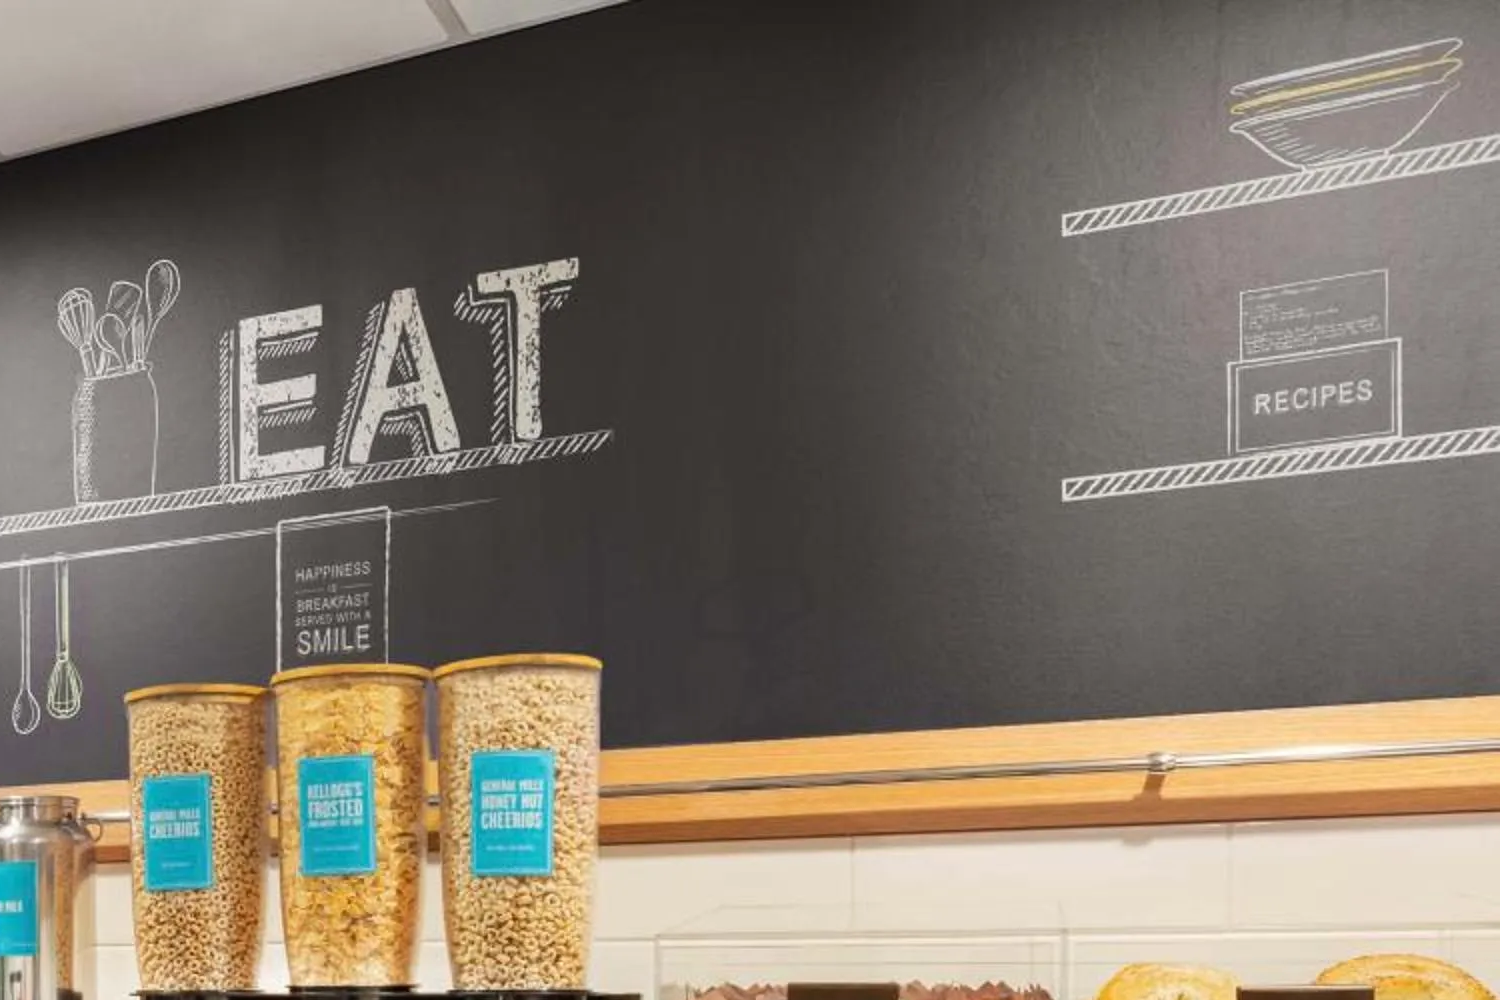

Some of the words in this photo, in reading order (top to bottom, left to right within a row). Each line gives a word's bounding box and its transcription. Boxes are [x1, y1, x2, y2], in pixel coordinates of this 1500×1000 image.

[236, 257, 580, 481] EAT
[1254, 378, 1374, 415] RECIPES
[294, 561, 372, 582] HAPPINESS
[296, 592, 370, 613] BREAKFAST
[294, 613, 333, 627] SERVED
[336, 611, 361, 623] WITH
[364, 610, 371, 621] A
[296, 623, 371, 655] SMILE
[307, 798, 363, 819] FROSTED
[149, 820, 200, 839] CHEERIOS
[481, 810, 543, 829] CHEERIOS
